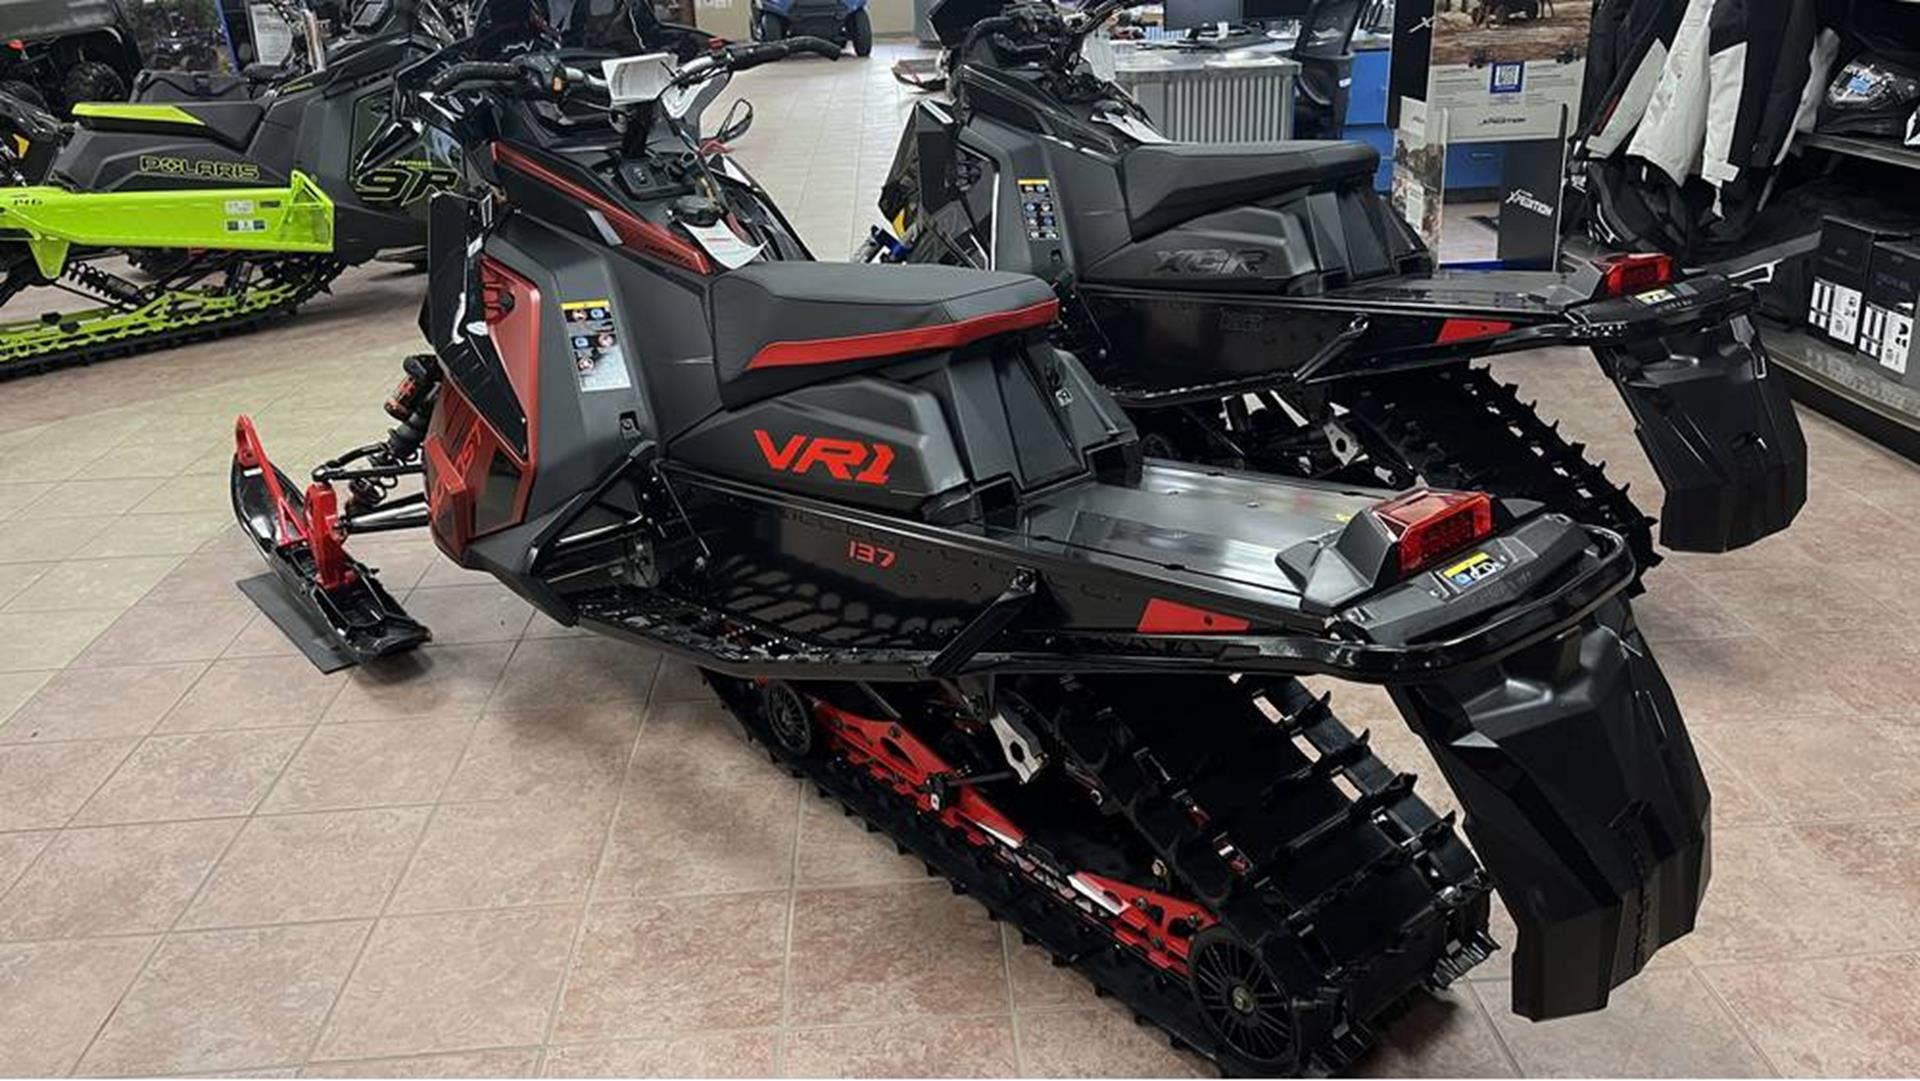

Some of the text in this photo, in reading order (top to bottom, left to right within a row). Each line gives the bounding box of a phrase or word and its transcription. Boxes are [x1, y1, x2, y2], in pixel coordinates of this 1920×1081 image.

[140, 155, 260, 180] POLARIS
[1153, 248, 1268, 275] XCR
[752, 429, 895, 484] VR1
[850, 540, 896, 567] 137
